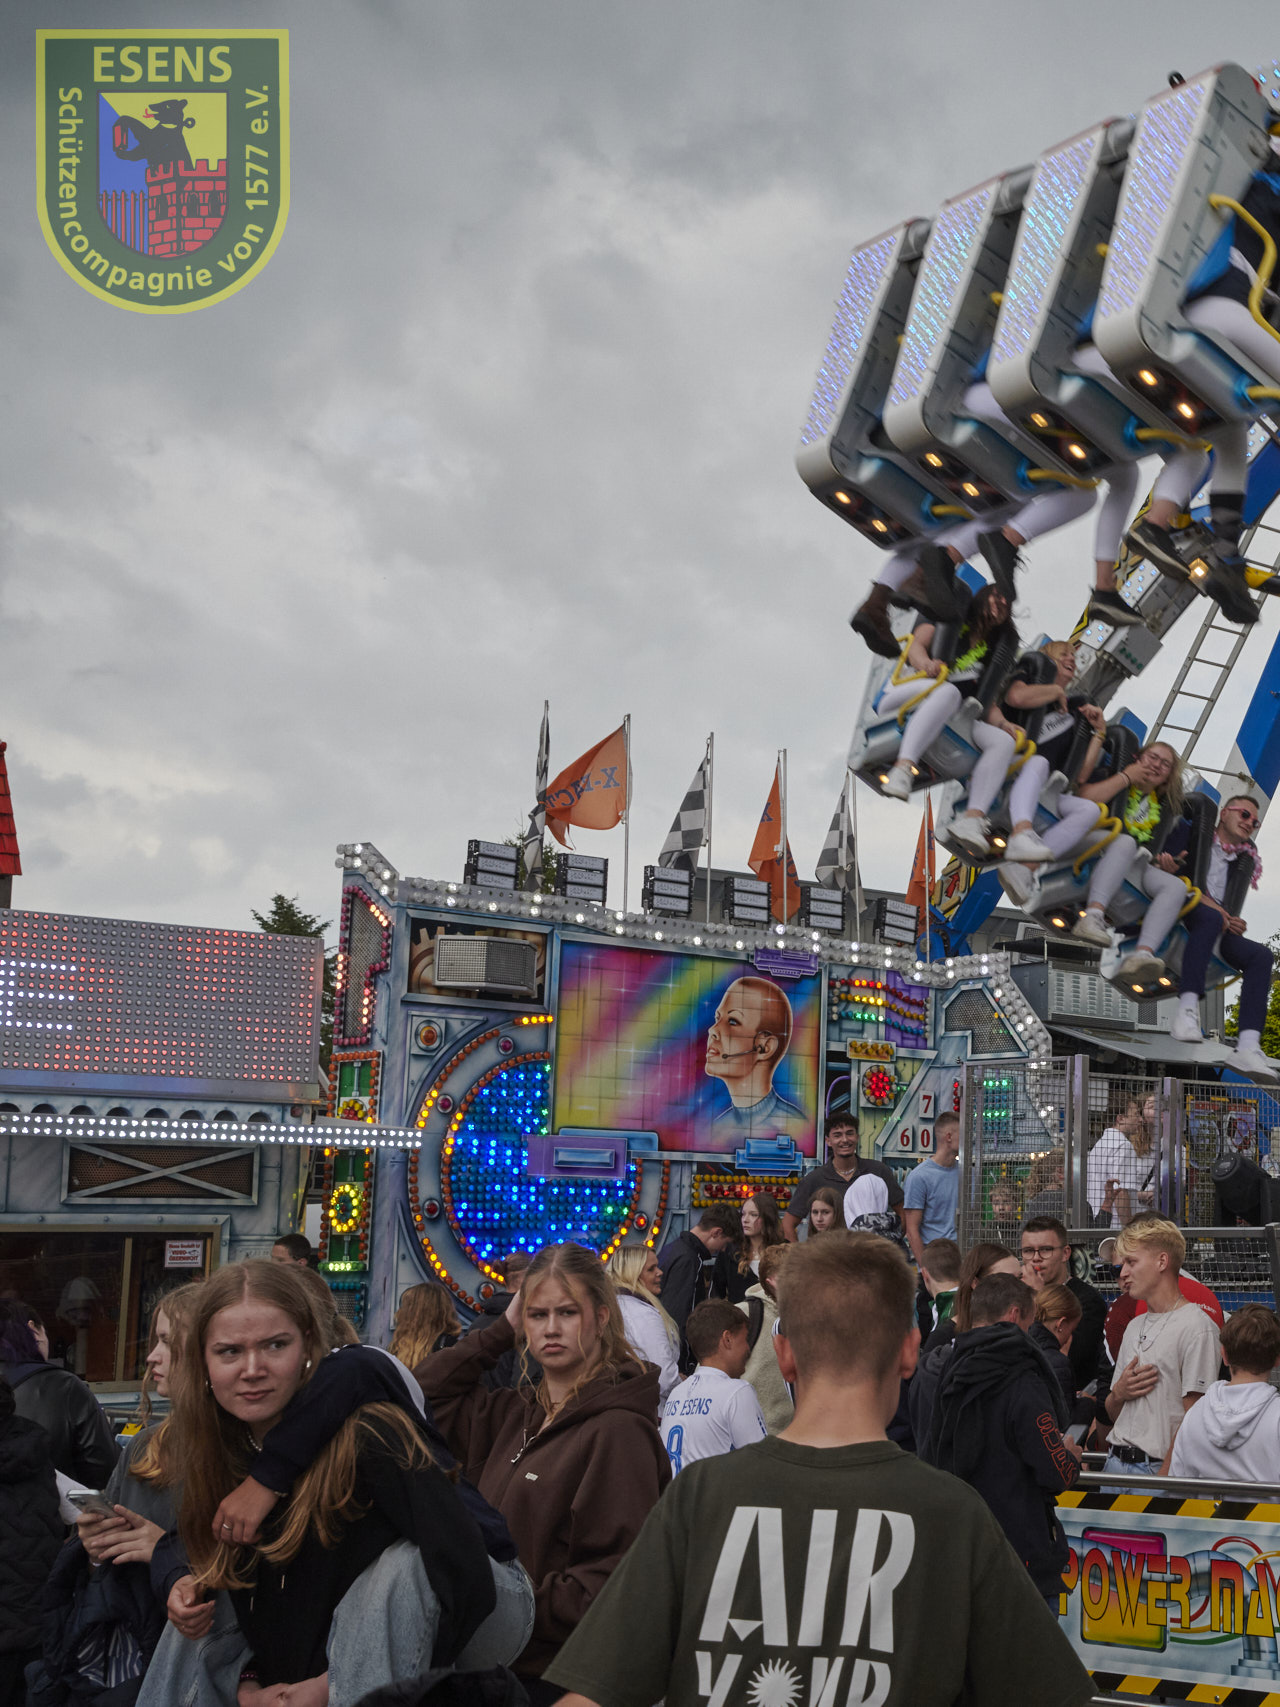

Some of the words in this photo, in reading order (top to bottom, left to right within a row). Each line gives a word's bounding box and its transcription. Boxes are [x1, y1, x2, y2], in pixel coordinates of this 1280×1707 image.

[922, 1094, 933, 1114] 7
[680, 1398, 713, 1416] ESENS
[698, 1505, 916, 1654] AIR
